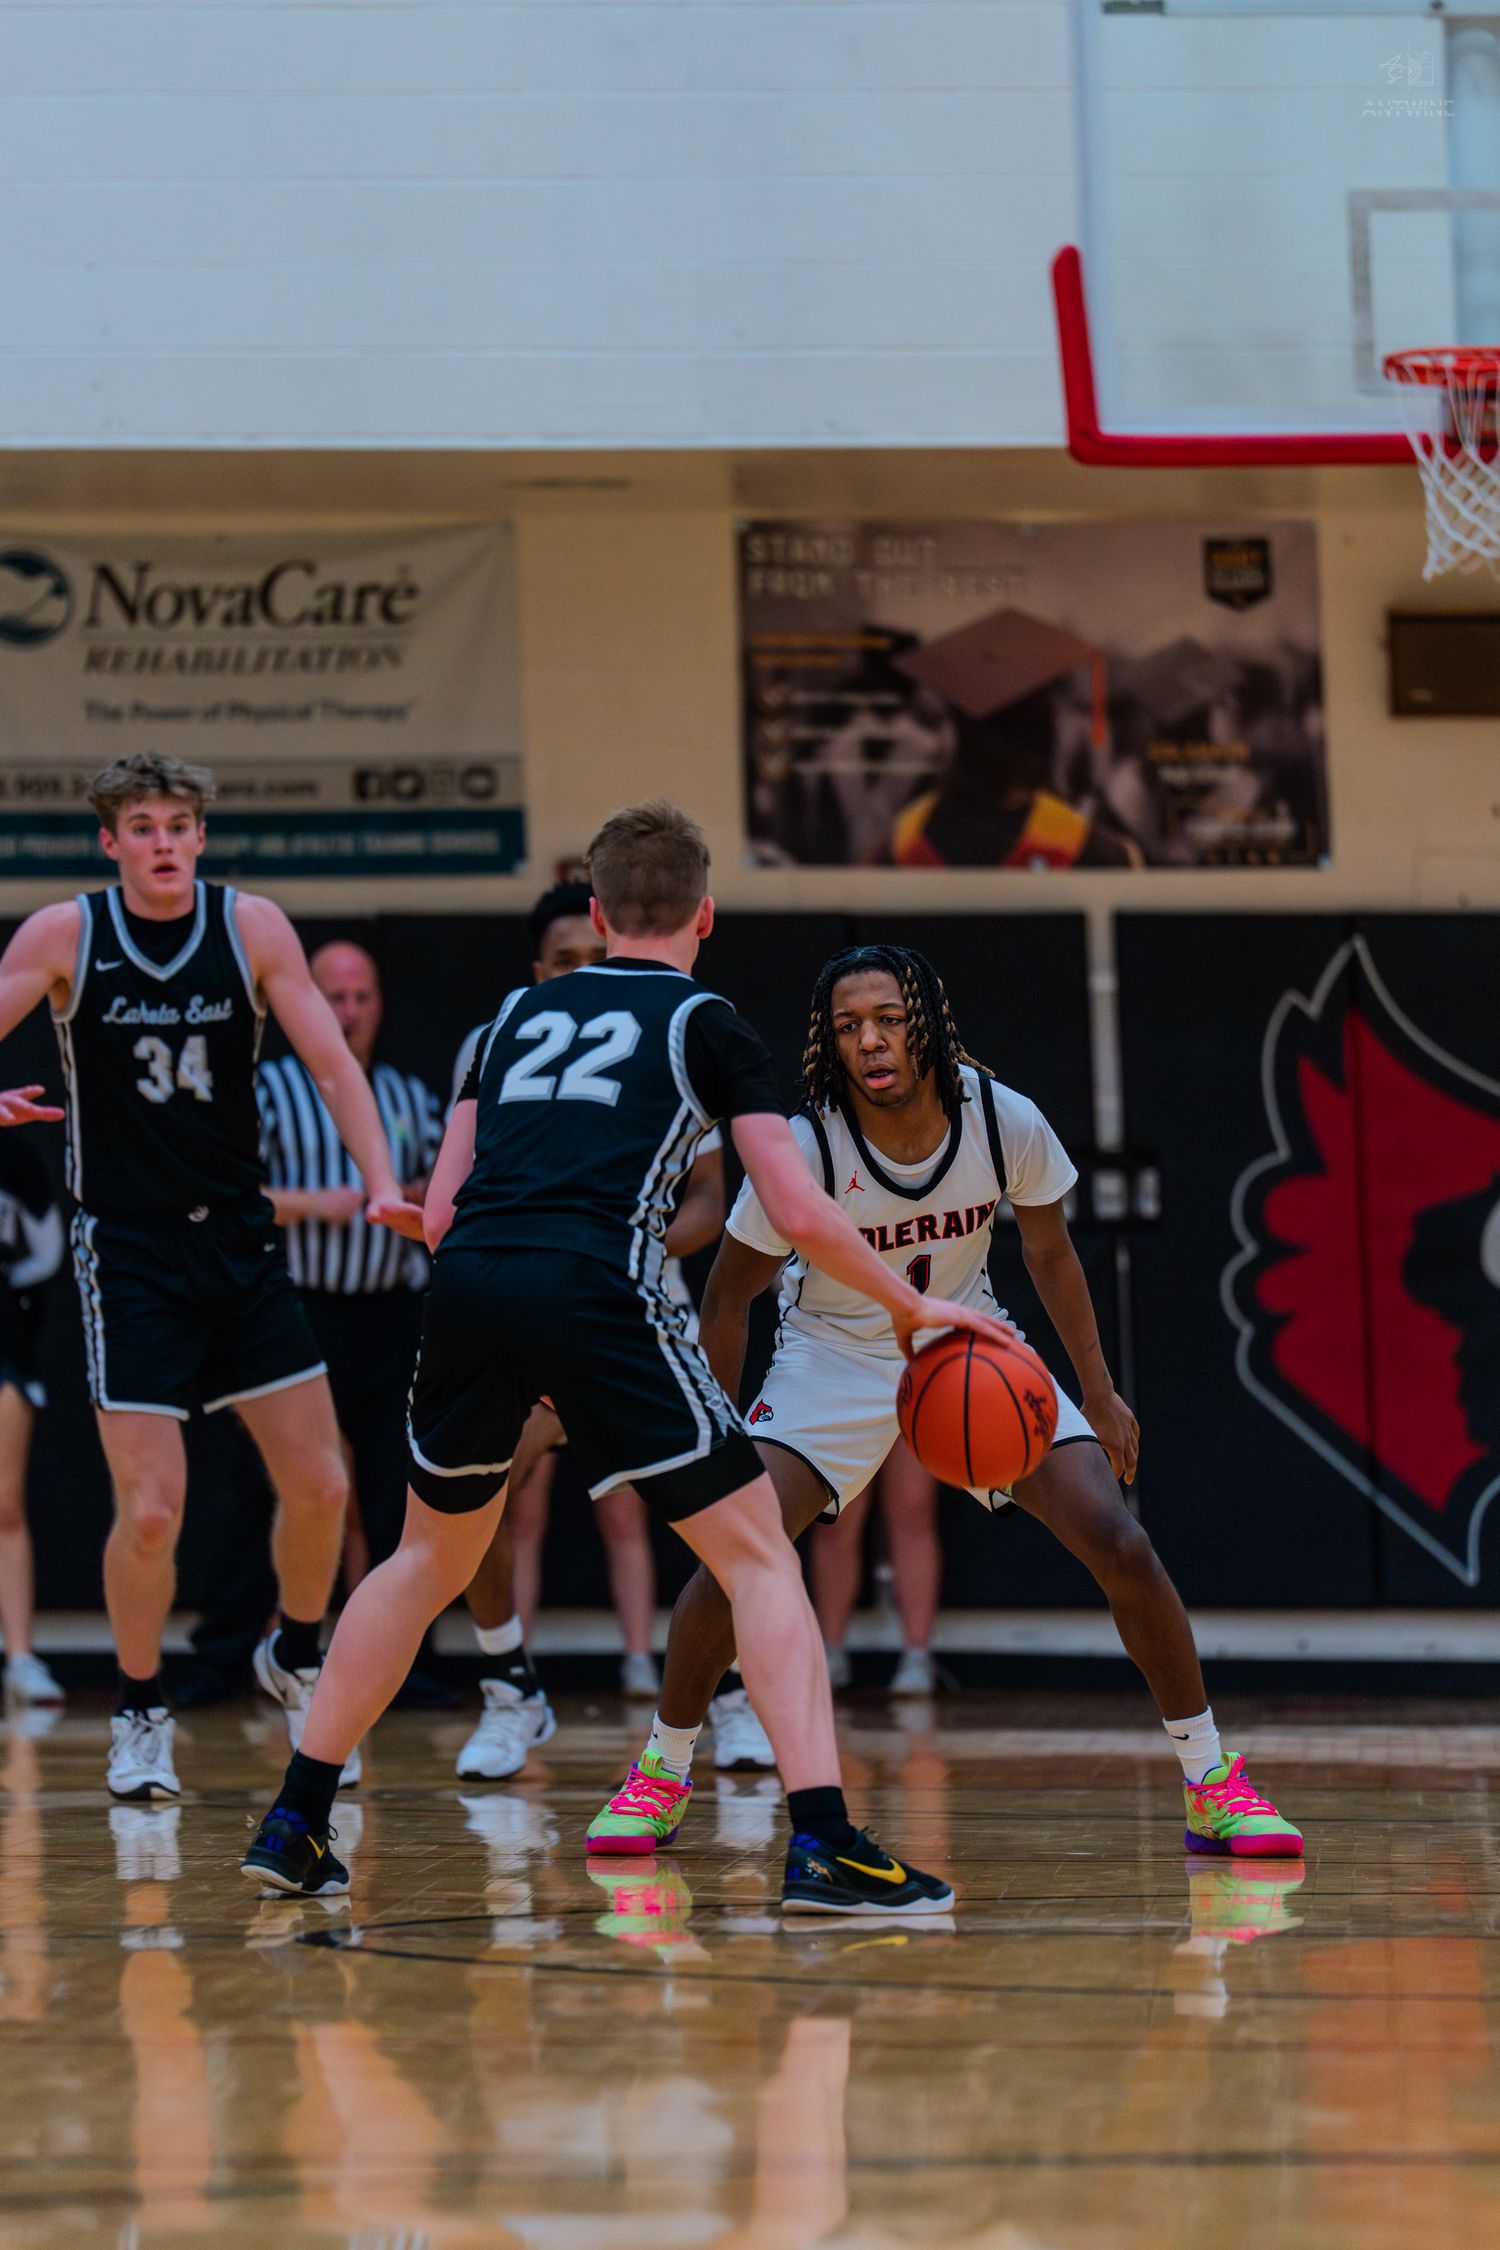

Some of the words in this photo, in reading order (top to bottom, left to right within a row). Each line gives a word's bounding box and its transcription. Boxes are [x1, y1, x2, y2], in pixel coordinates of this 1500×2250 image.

[84, 559, 419, 629] NovaCare
[184, 994, 233, 1025] East
[133, 1035, 213, 1104] 34
[498, 1010, 643, 1107] 22
[906, 1254, 932, 1296] 1
